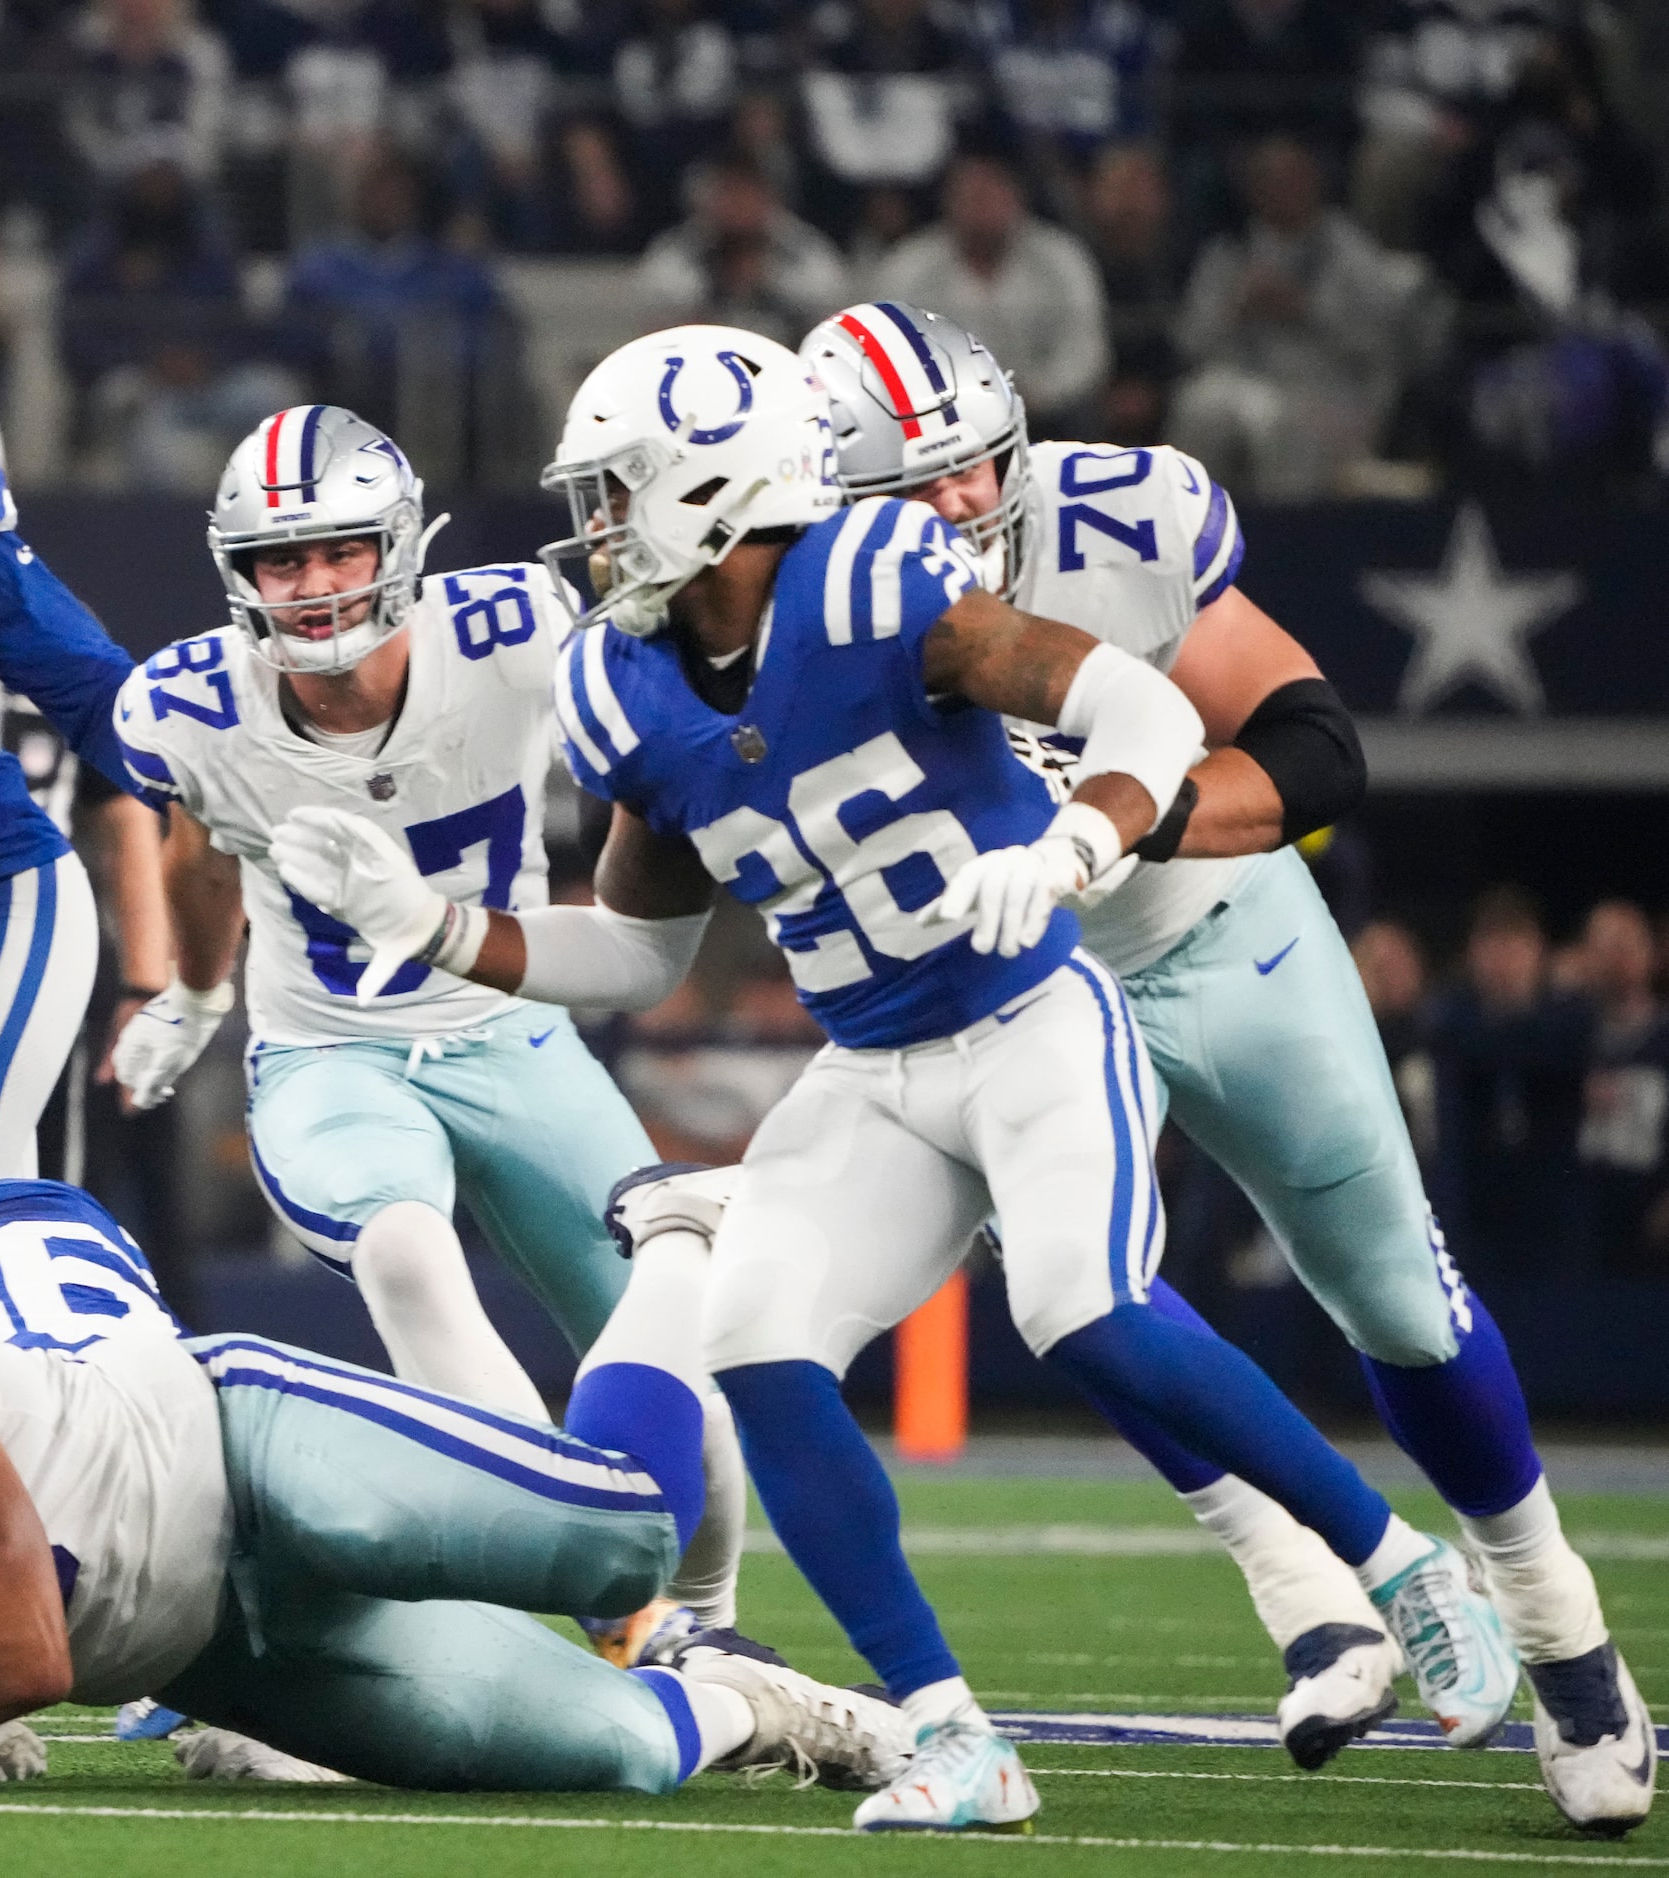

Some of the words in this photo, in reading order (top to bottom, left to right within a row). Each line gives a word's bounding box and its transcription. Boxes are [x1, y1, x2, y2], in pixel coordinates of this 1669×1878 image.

[1058, 447, 1159, 572] 70
[444, 567, 536, 661] 87
[146, 636, 241, 731] 87
[688, 730, 979, 994] 26
